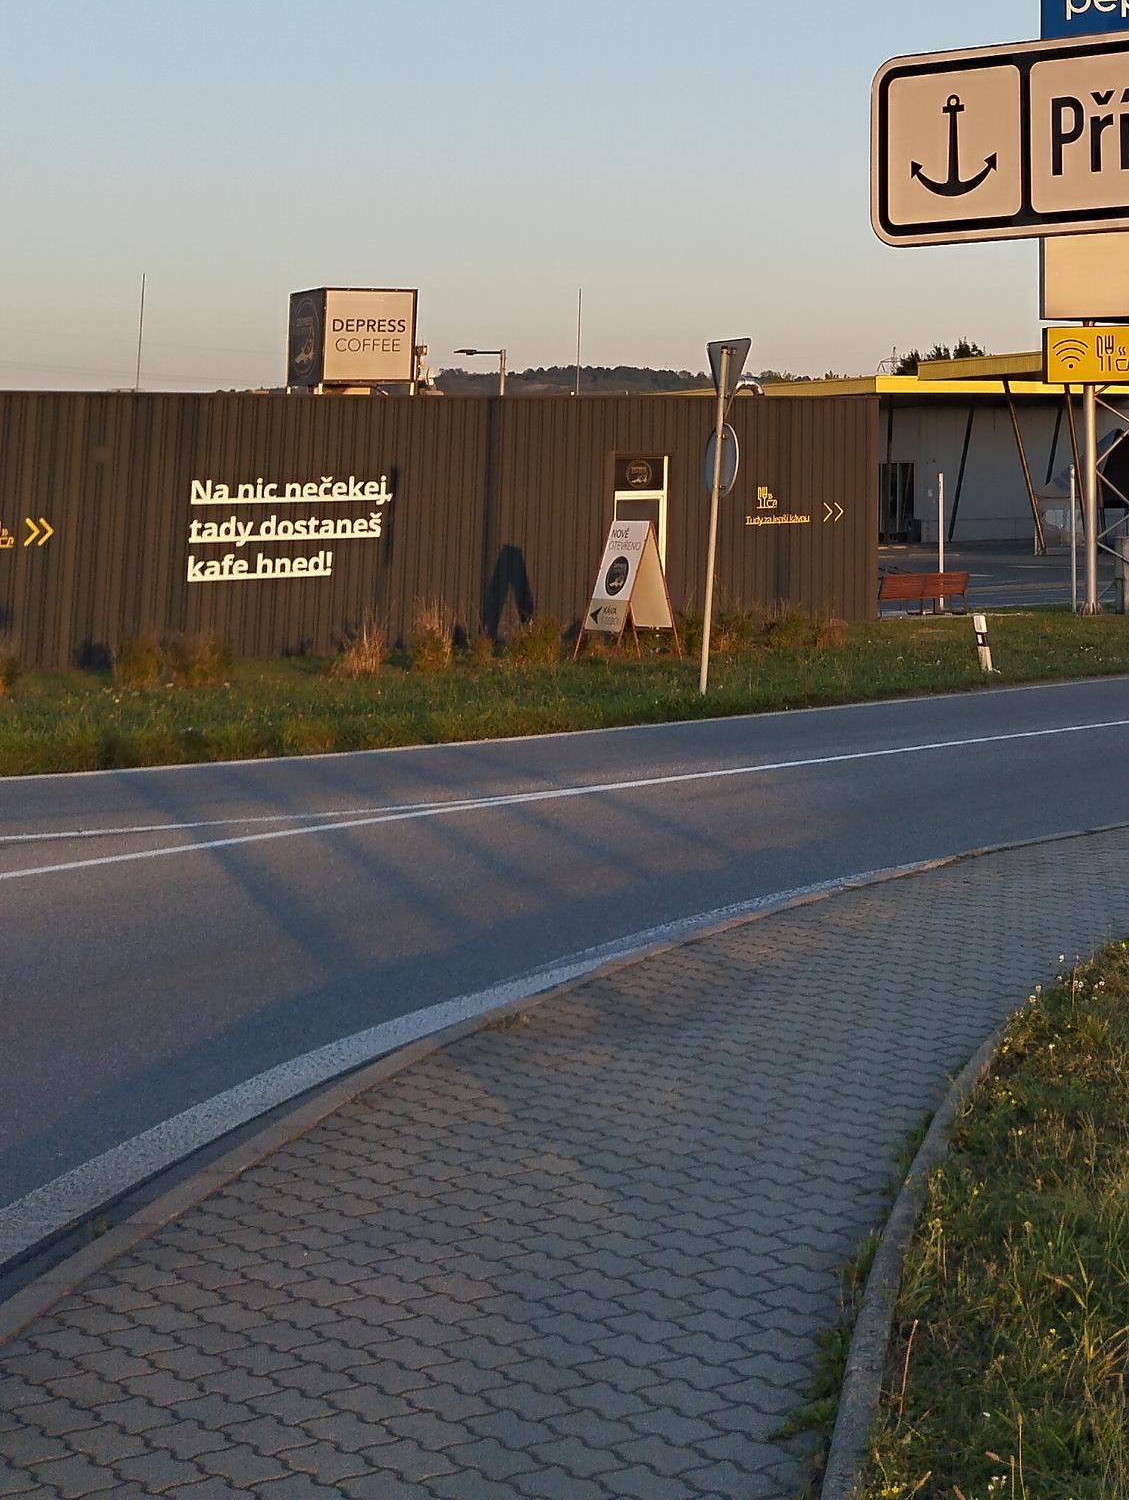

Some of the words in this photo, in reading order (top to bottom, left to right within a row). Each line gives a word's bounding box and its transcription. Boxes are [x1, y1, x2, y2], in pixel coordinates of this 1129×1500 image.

[332, 318, 406, 333] DEPRESS
[335, 337, 401, 352] COFFEE
[191, 479, 230, 504] Na
[237, 477, 278, 503] nic
[285, 475, 394, 505] nečekej,
[189, 515, 254, 547] tady
[260, 512, 383, 541] dostaneš
[611, 527, 630, 539] NOVÉ
[187, 554, 249, 582] kafe
[256, 550, 333, 579] hned!
